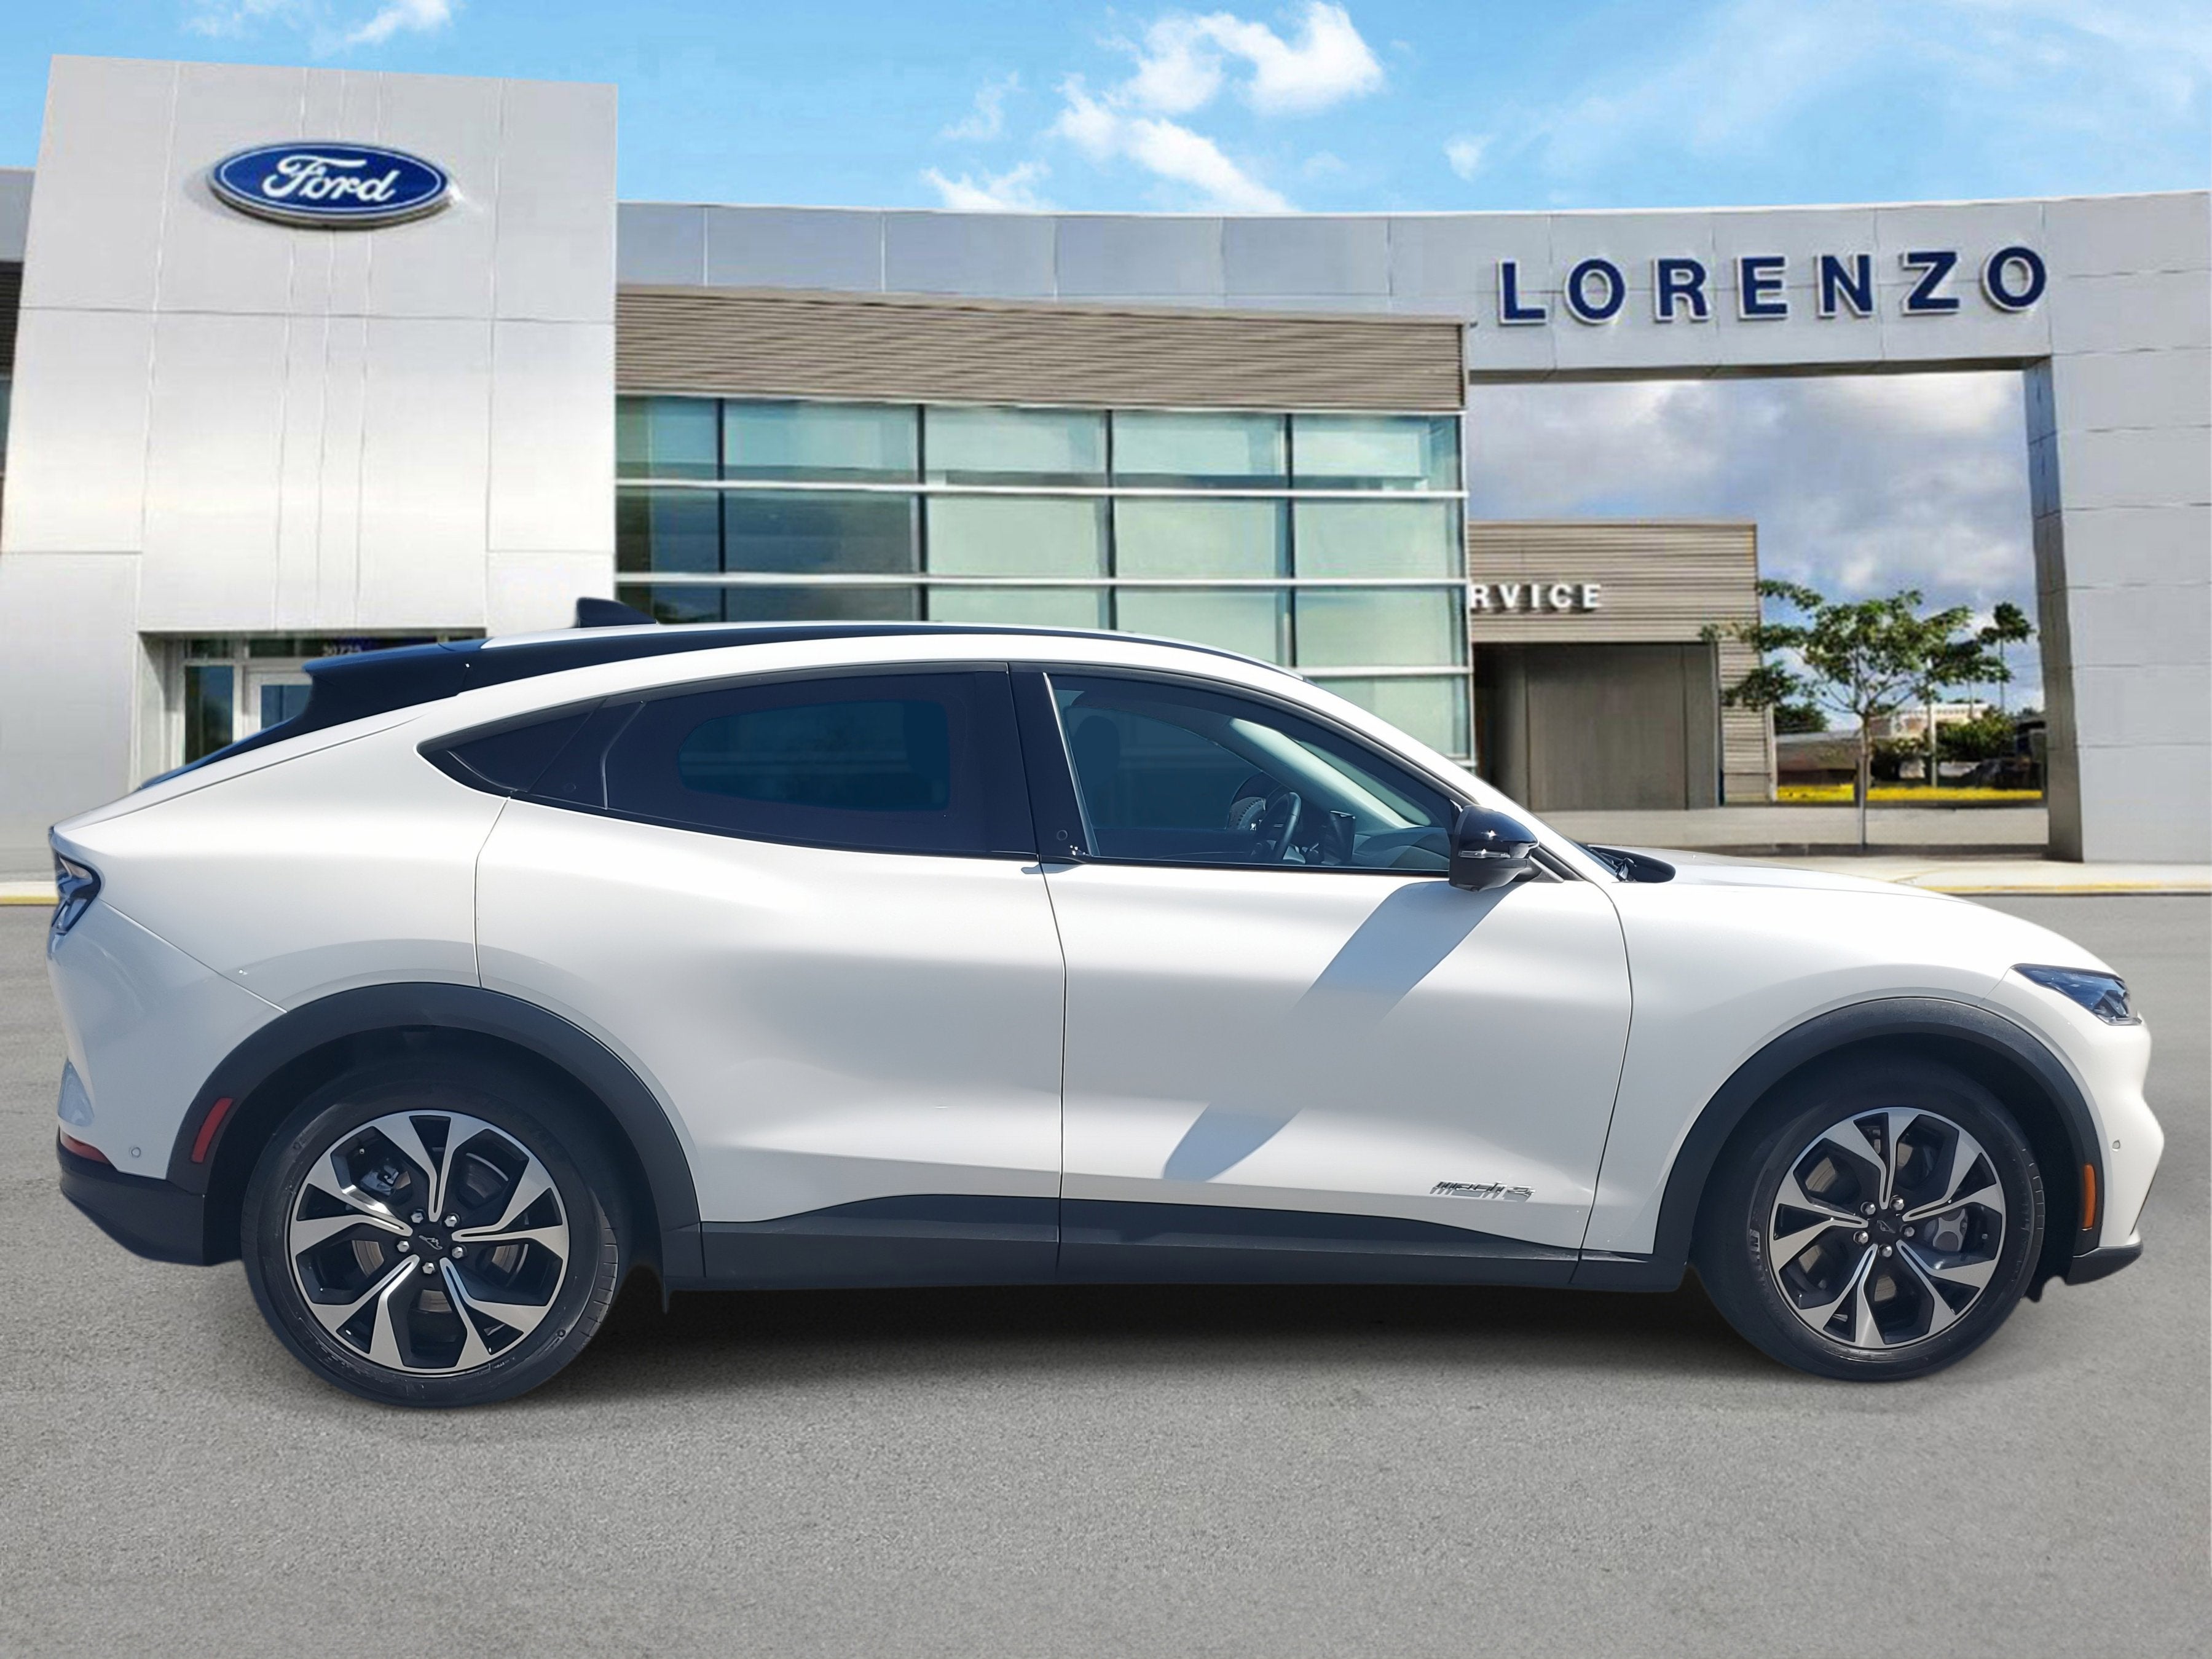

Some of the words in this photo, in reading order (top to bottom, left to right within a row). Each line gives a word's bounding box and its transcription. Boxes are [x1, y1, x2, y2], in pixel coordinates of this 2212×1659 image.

[262, 154, 401, 202] Ford
[1498, 246, 2049, 325] LORENZO
[1470, 583, 1602, 608] RVICE
